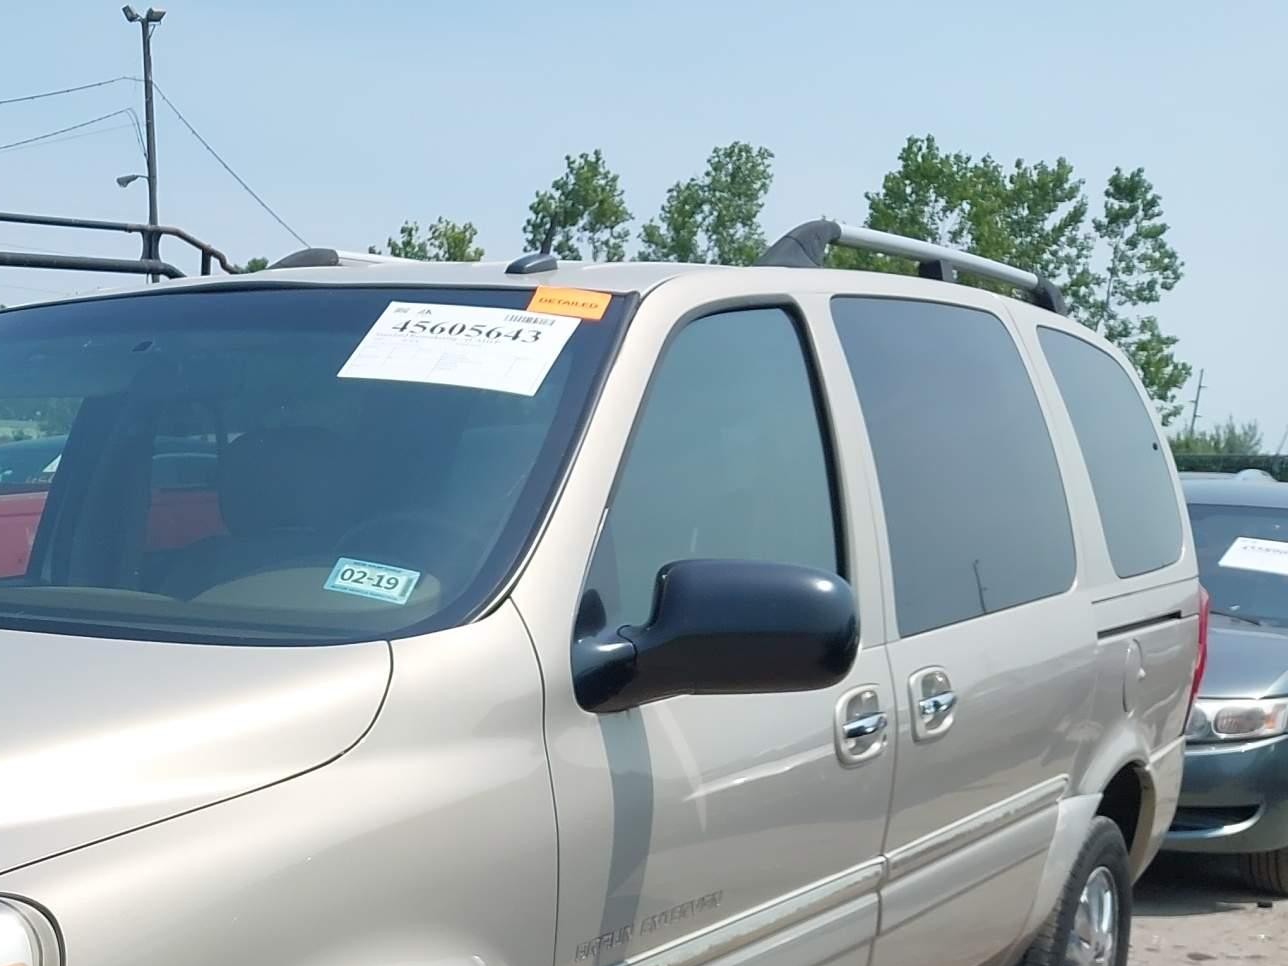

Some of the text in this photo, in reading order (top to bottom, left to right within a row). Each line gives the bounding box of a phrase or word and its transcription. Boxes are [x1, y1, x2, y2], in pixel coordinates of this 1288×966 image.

[539, 297, 599, 309] DETAILED
[391, 319, 543, 344] 45605643
[340, 567, 400, 591] 02-19
